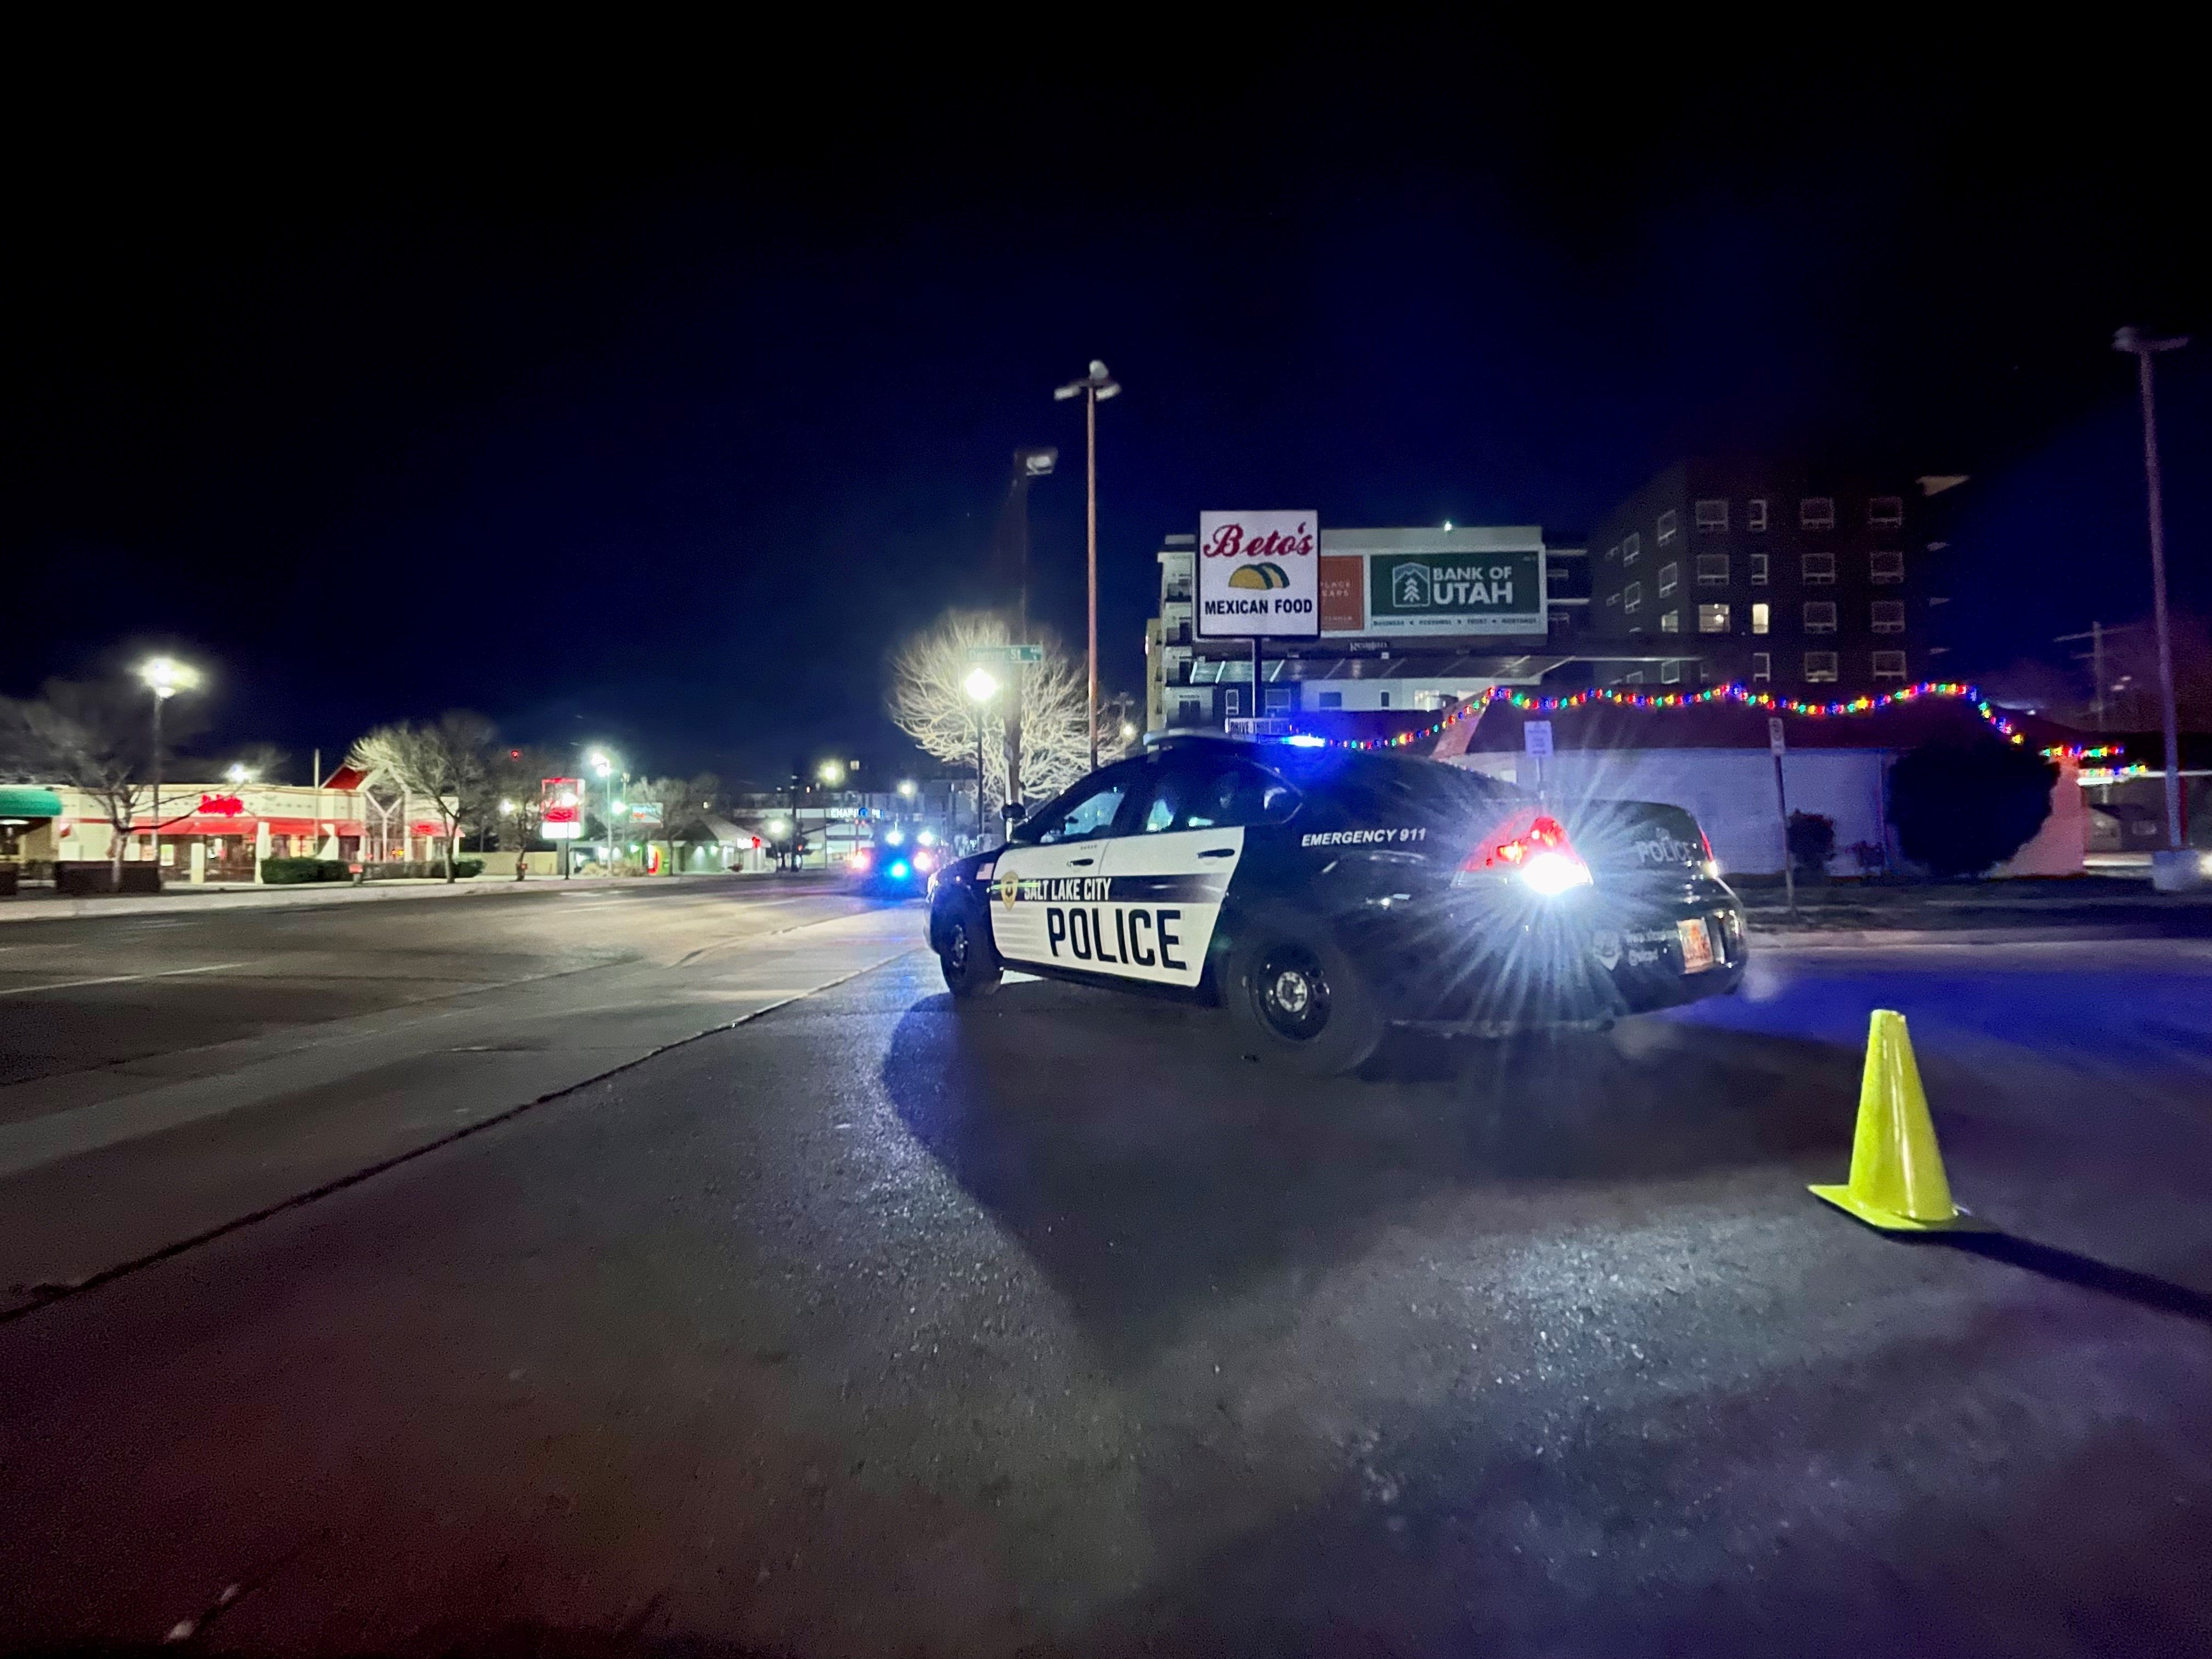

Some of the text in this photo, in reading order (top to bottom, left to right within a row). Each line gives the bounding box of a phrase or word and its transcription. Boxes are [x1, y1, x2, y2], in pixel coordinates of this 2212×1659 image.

[1203, 522, 1313, 557] Beto's
[1432, 566, 1512, 580] BANK OF
[1434, 582, 1513, 604] UTAH
[1205, 599, 1312, 614] MEXICAN FOOD
[1301, 827, 1426, 847] EMERGENCY 911
[1024, 877, 1111, 901] SALT LAKE CITY
[1047, 908, 1187, 970] POLICE
